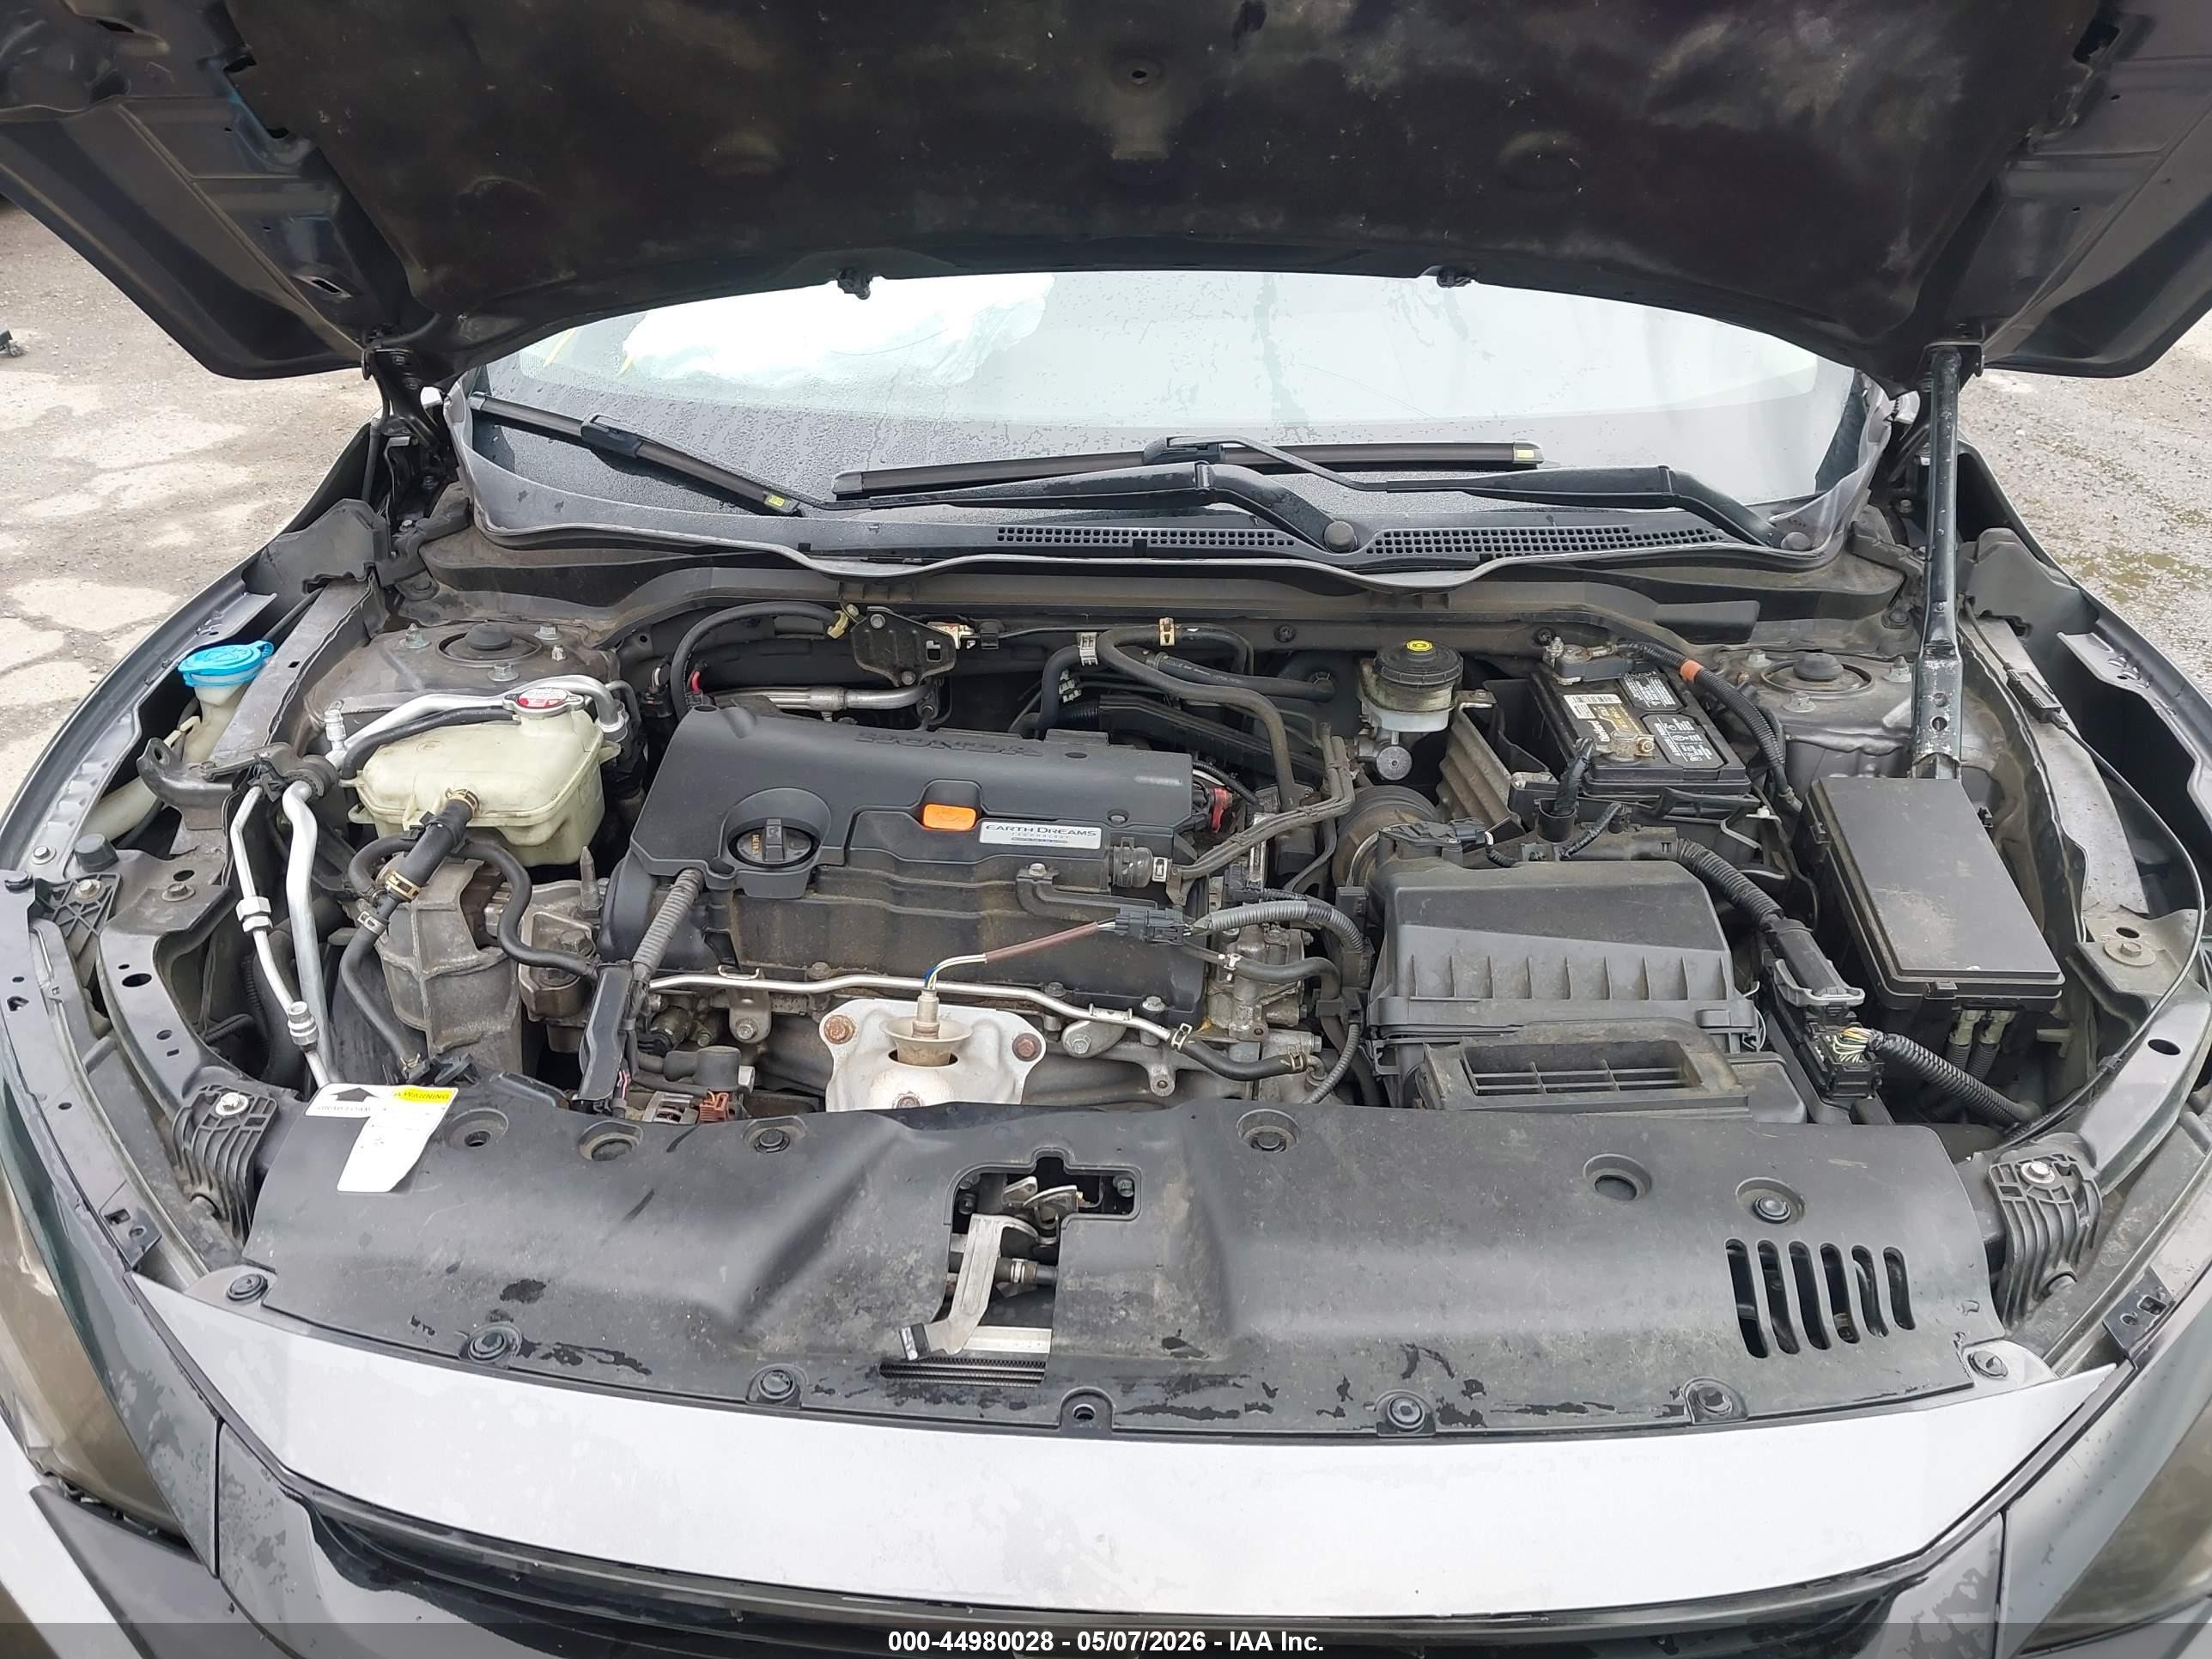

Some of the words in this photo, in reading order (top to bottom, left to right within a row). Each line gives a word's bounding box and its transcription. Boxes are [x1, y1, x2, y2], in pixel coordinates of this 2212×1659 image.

[986, 824, 1034, 834] EARTH
[1036, 827, 1097, 837] DREAMS
[404, 1091, 450, 1101] WARNING
